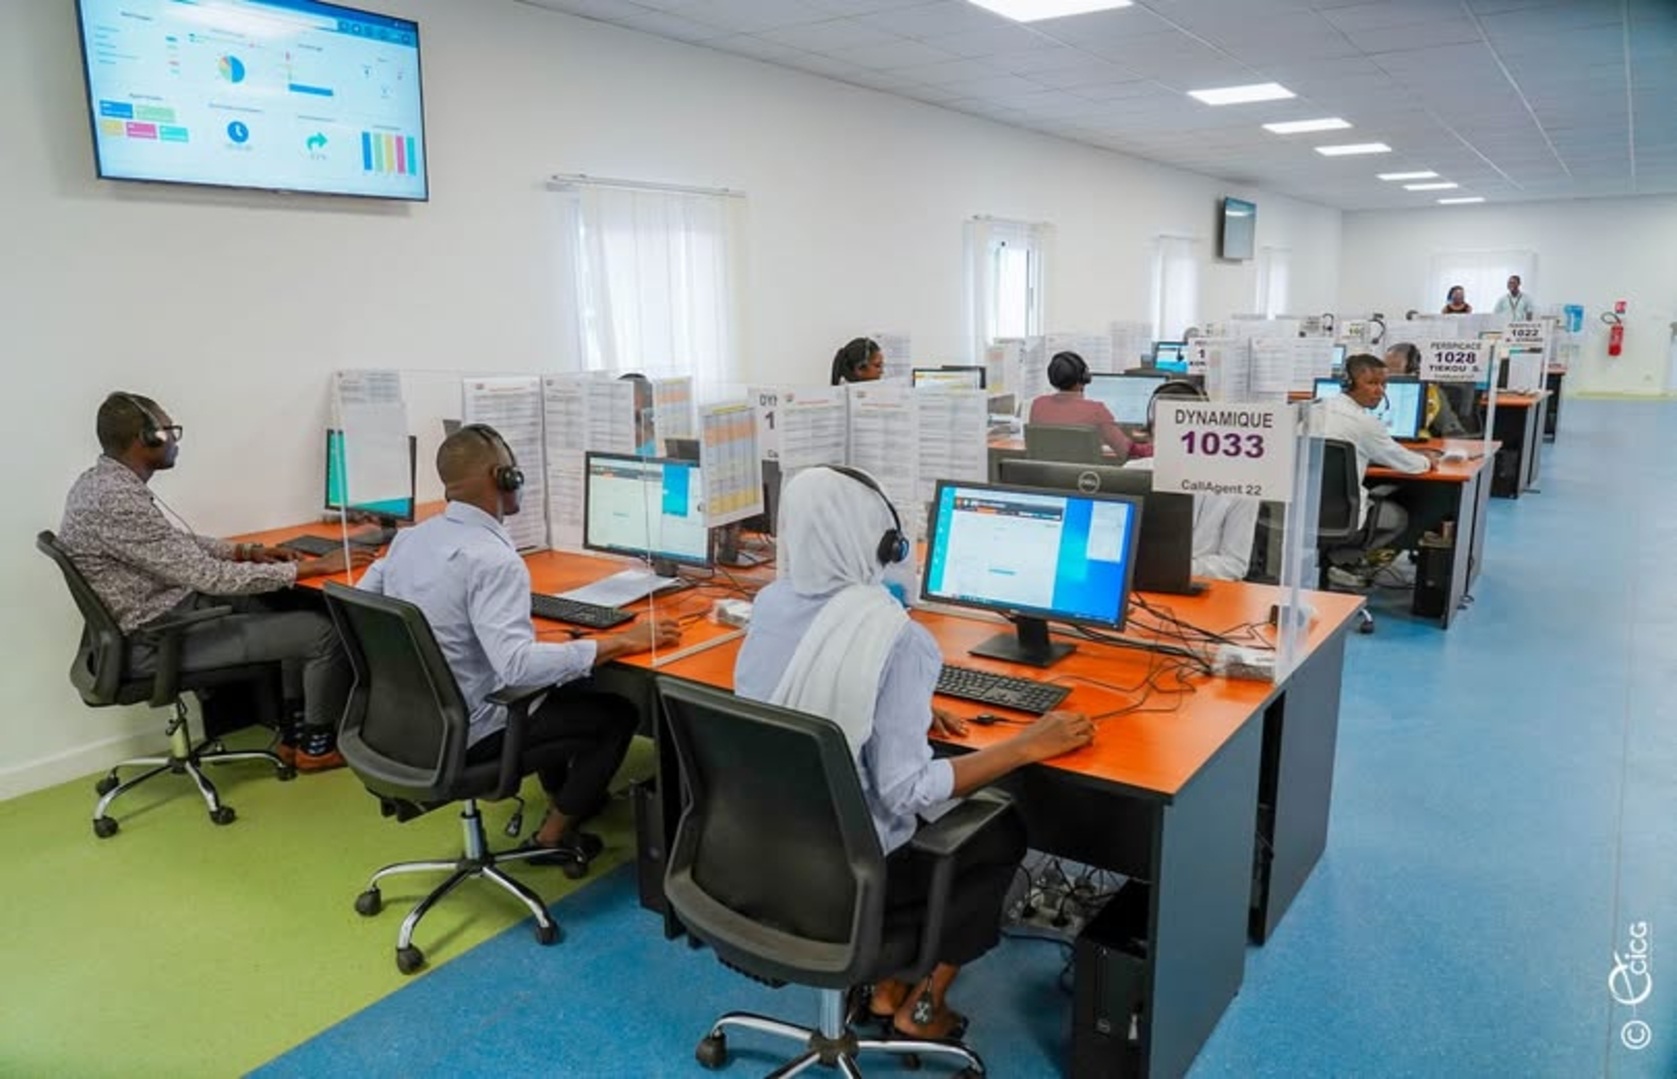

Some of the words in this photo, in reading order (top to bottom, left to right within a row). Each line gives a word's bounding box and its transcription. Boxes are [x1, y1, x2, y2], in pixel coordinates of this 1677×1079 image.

[1434, 351, 1476, 364] 1028
[1175, 409, 1273, 428] DYNAMIQUE
[1181, 430, 1264, 458] 1033
[1181, 479, 1243, 494] CallAgent
[1246, 484, 1262, 496] 22
